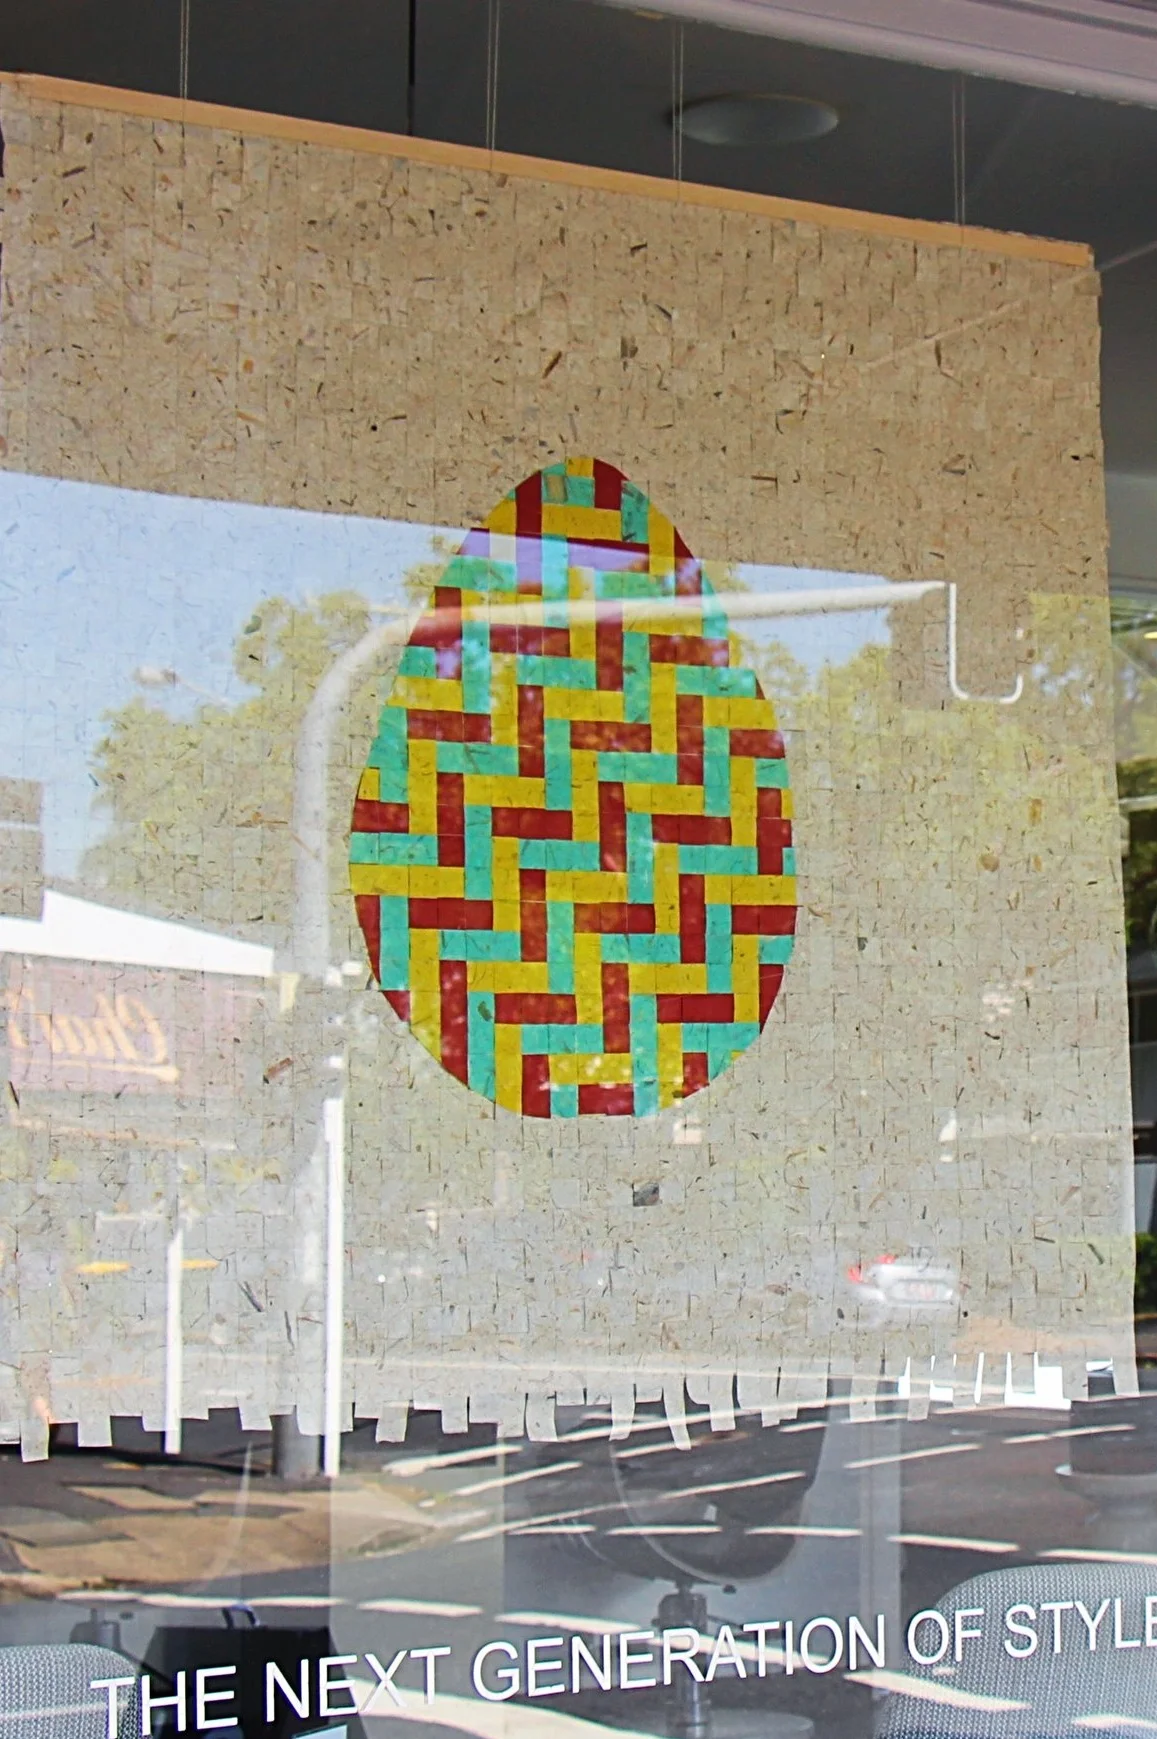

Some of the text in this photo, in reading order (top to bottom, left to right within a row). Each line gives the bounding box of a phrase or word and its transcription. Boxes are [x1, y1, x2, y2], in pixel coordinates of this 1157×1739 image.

[90, 1665, 239, 1739] THE
[265, 1646, 452, 1723] NEXT
[472, 1613, 886, 1702] GENERATION
[906, 1608, 985, 1666] OF
